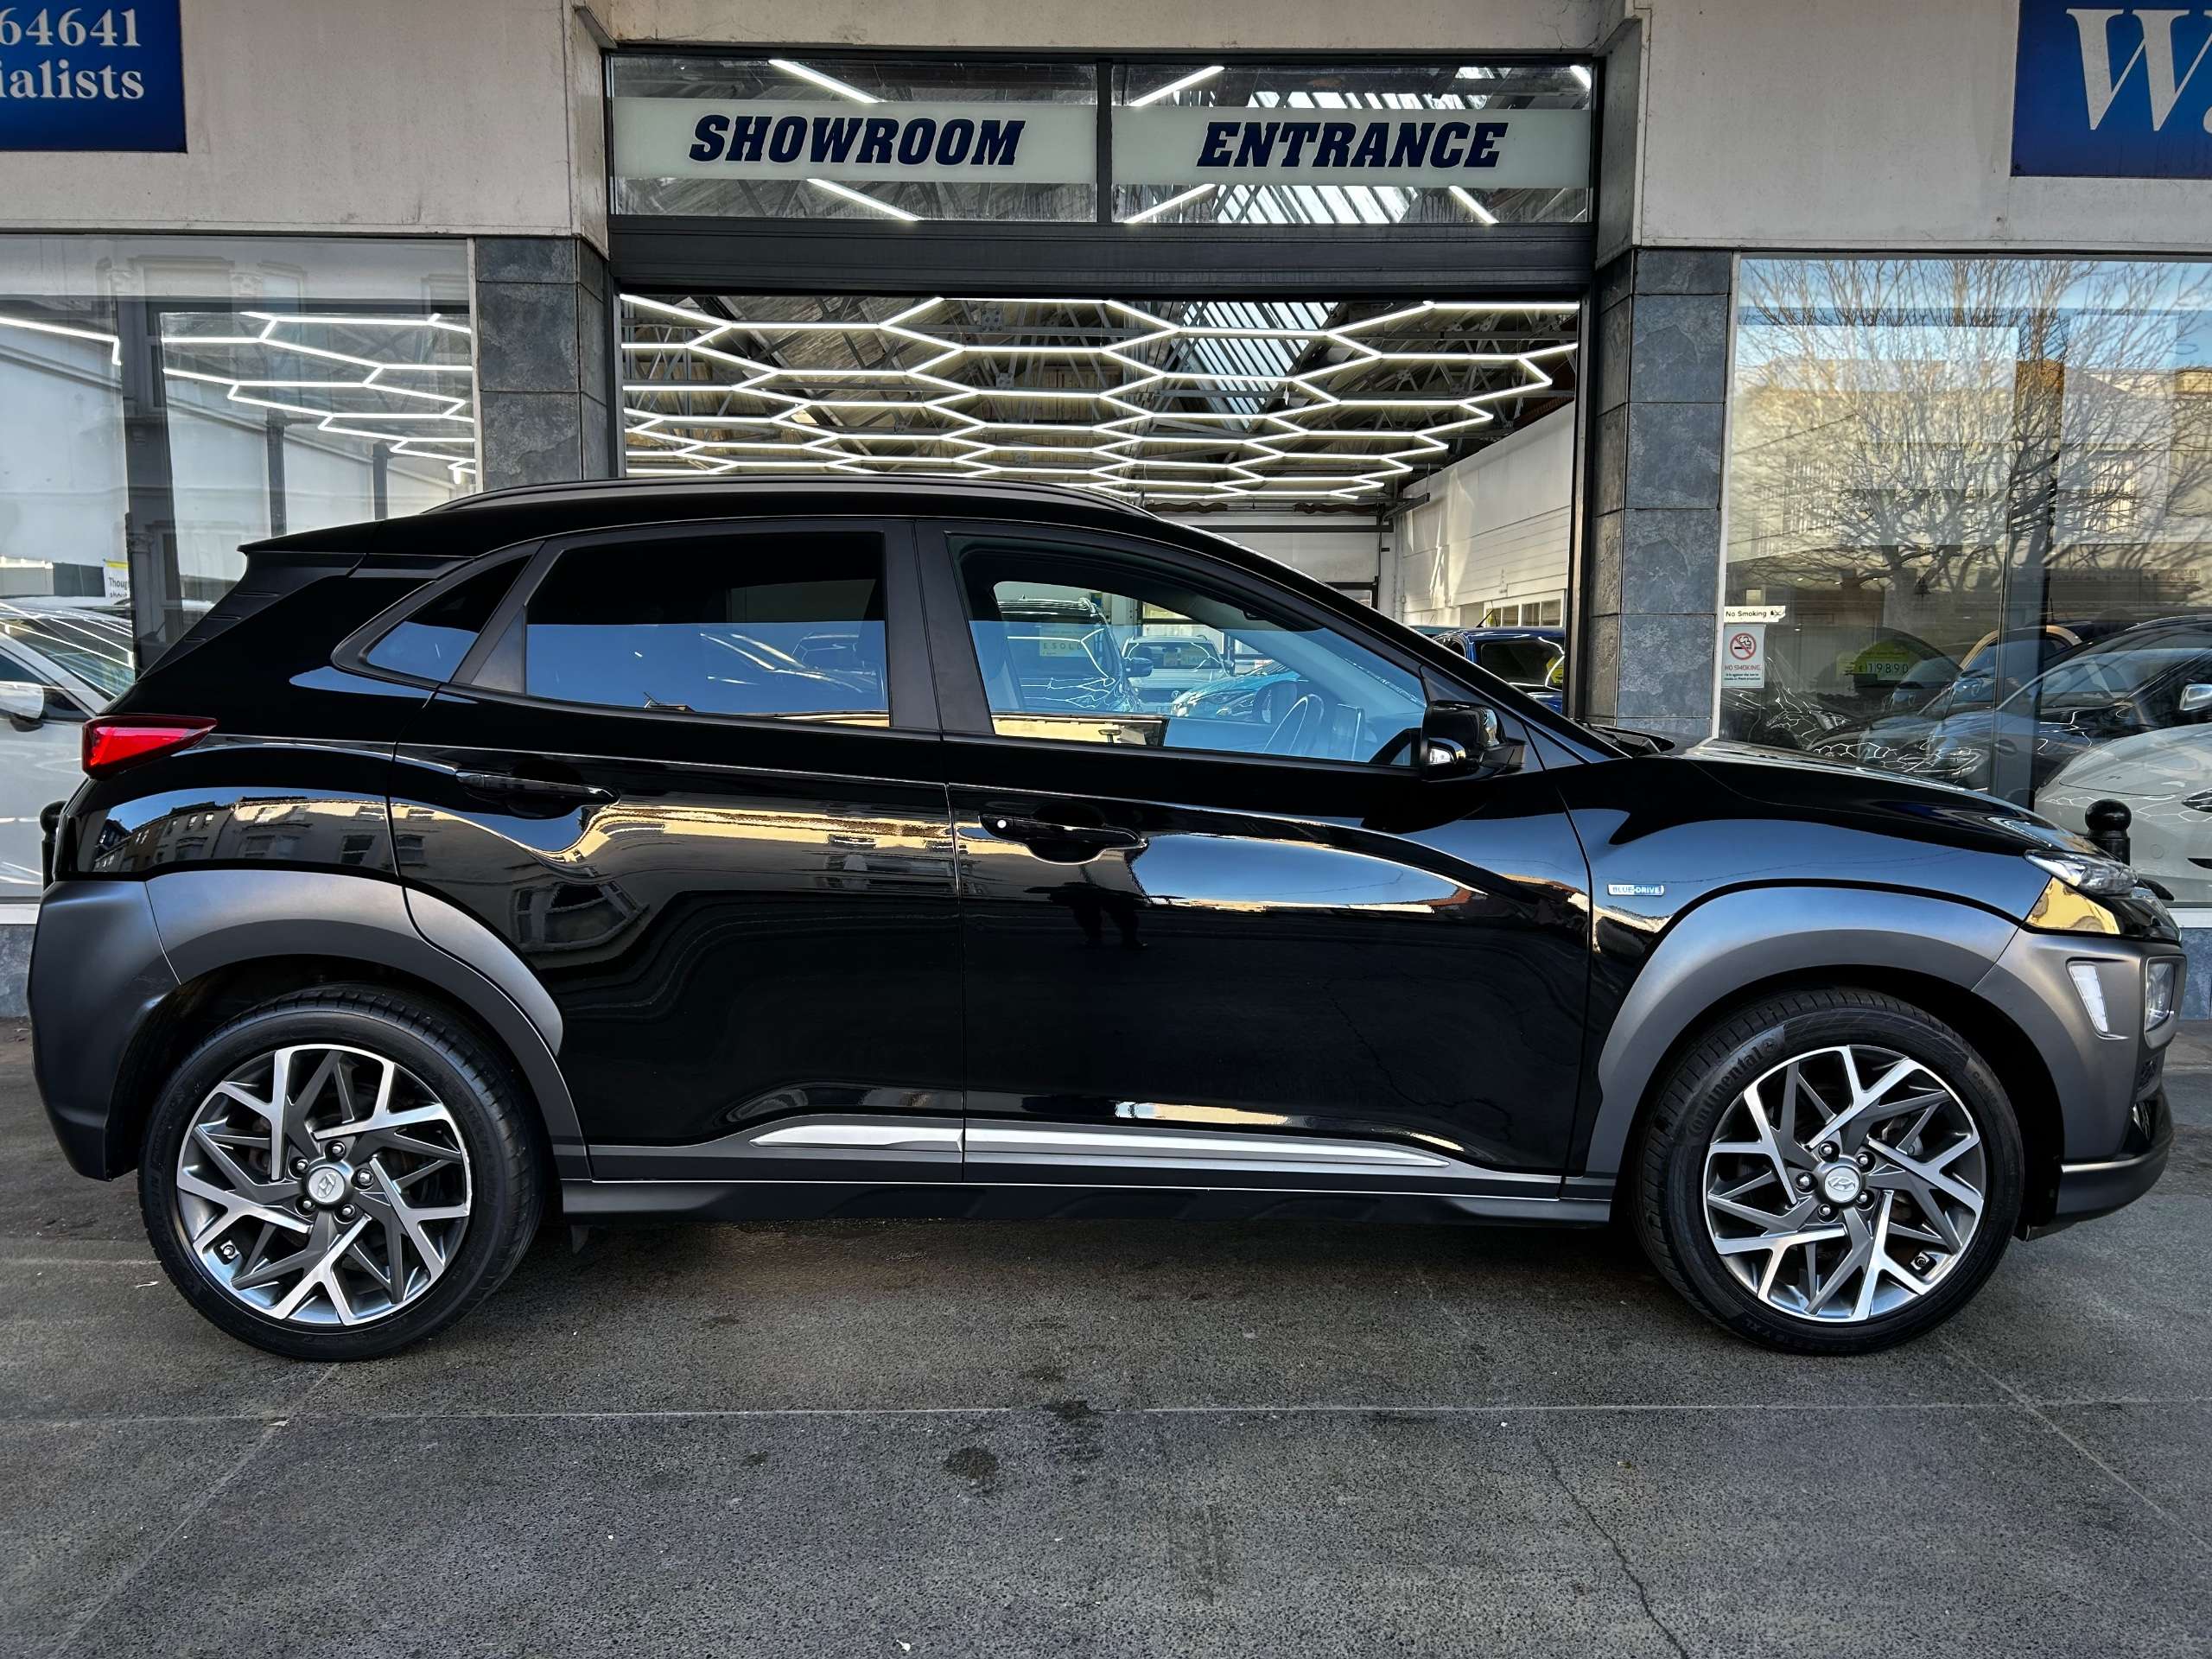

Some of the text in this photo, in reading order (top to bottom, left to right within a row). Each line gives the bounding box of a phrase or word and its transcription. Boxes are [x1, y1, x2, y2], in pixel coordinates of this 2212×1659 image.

[0, 8, 141, 47] 64641
[689, 114, 1026, 166] SHOWROOM
[1196, 121, 1509, 168] ENTRANCE
[1738, 610, 1767, 619] Smoking
[1686, 1046, 1764, 1135] Continental
